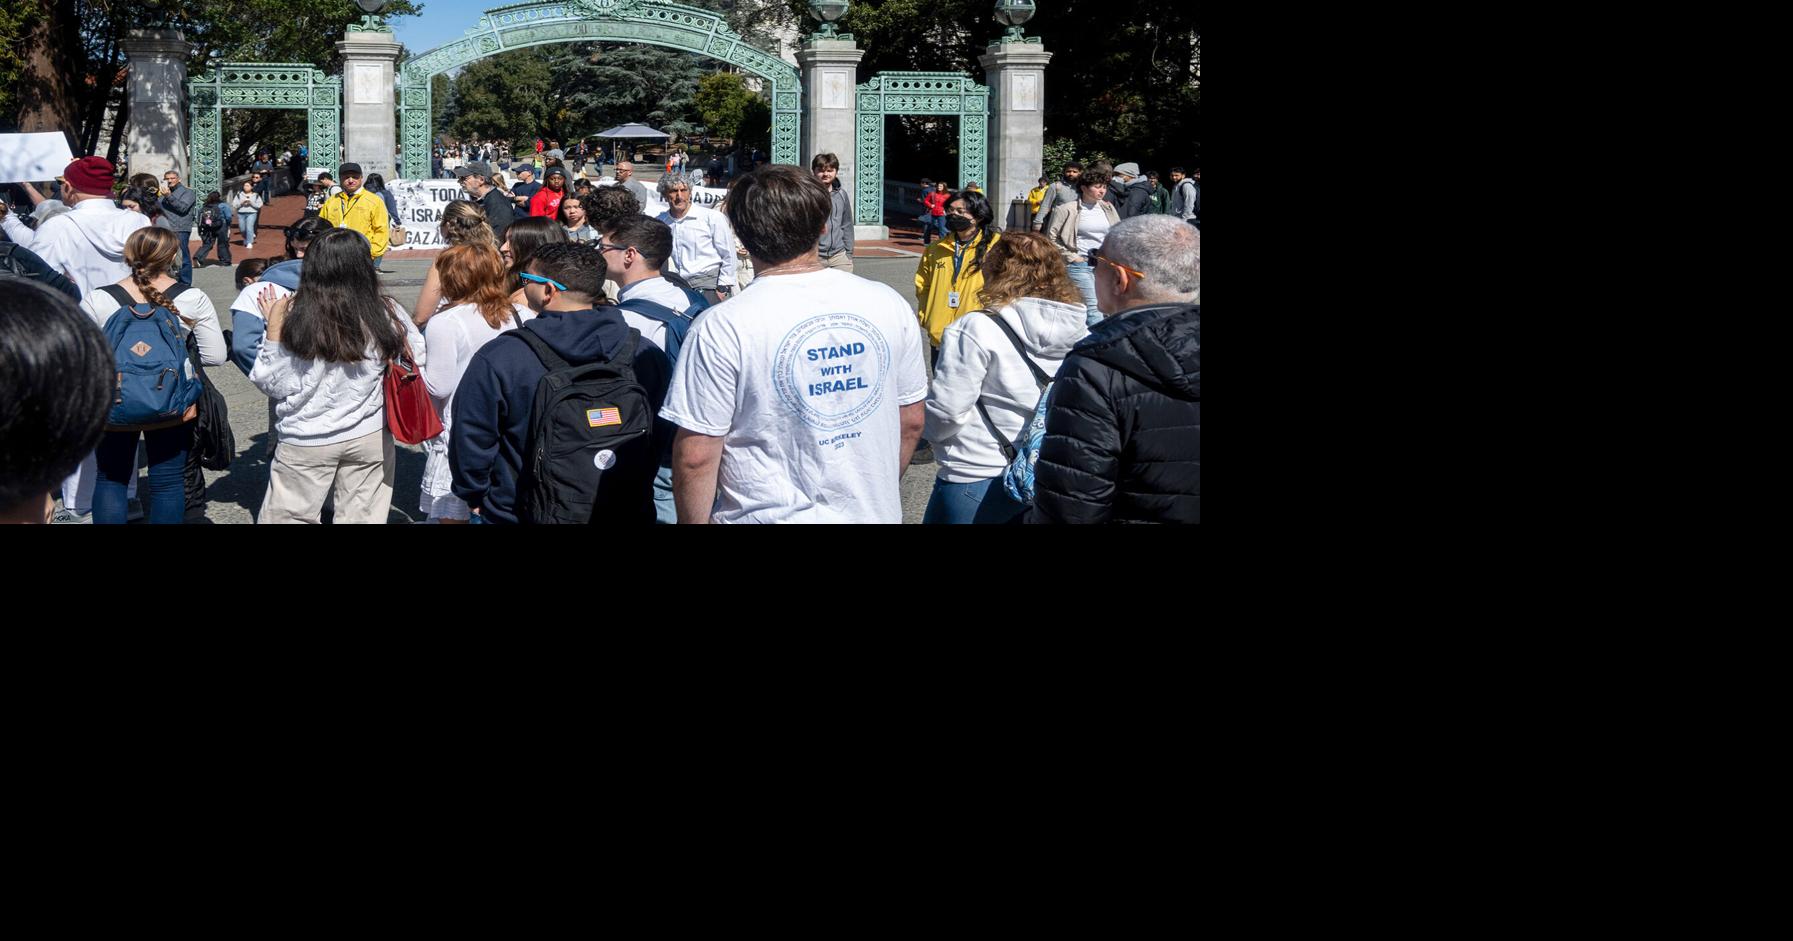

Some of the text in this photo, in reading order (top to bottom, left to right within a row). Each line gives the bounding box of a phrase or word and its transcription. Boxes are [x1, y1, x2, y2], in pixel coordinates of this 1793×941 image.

[430, 188, 467, 202] TODA
[412, 208, 443, 222] ISRA
[806, 342, 865, 361] STAND
[820, 364, 852, 377] WITH
[808, 376, 868, 396] ISRAEL
